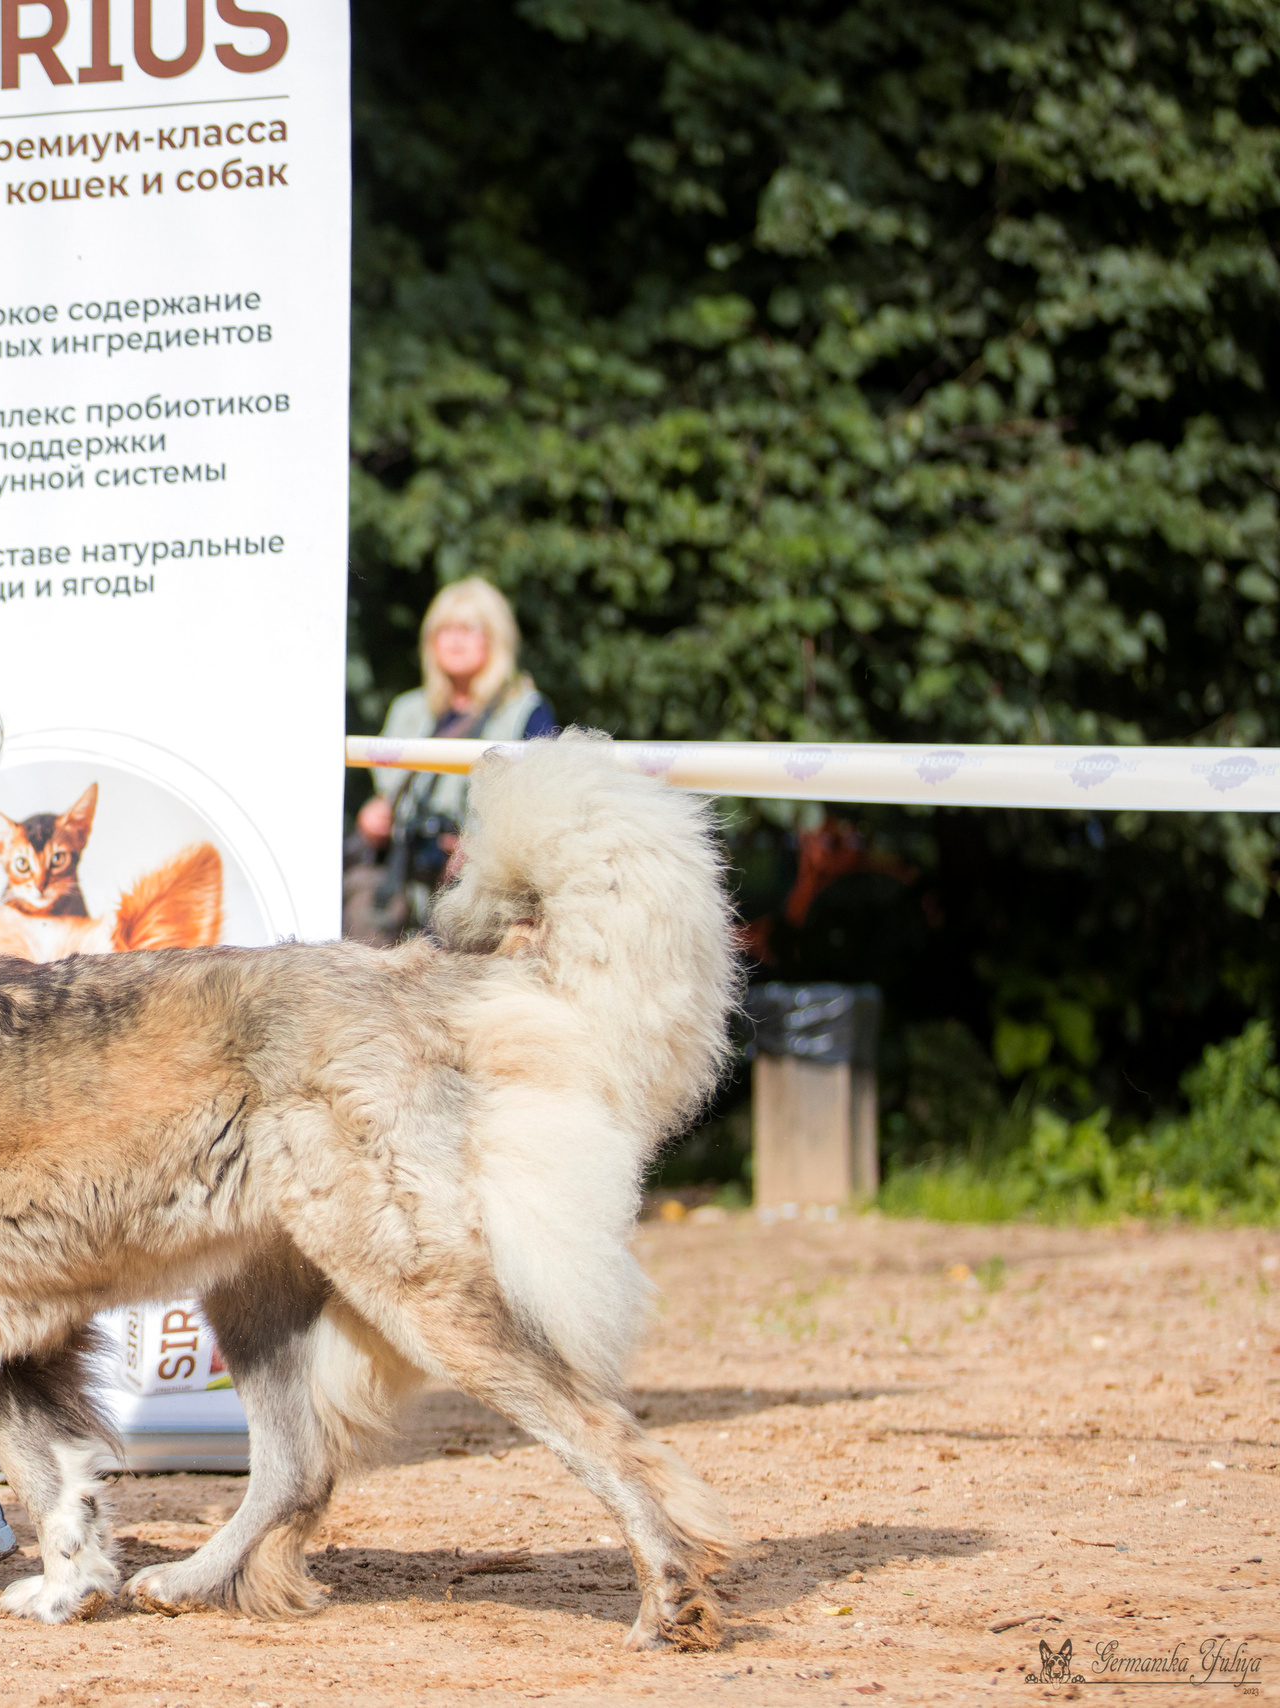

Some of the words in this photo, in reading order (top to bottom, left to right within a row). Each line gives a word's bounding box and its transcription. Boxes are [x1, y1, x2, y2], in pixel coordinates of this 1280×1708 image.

[7, 174, 129, 204] кошек
[143, 173, 162, 195] и
[176, 157, 289, 192] собак
[68, 292, 261, 323] содержание
[52, 324, 273, 358] ингредиентов
[86, 393, 290, 428] пробиотиков
[95, 463, 226, 488] системы
[82, 535, 285, 567] натуральные
[35, 580, 52, 598] и
[63, 575, 154, 598] ягоды
[157, 1308, 200, 1381] SIR
